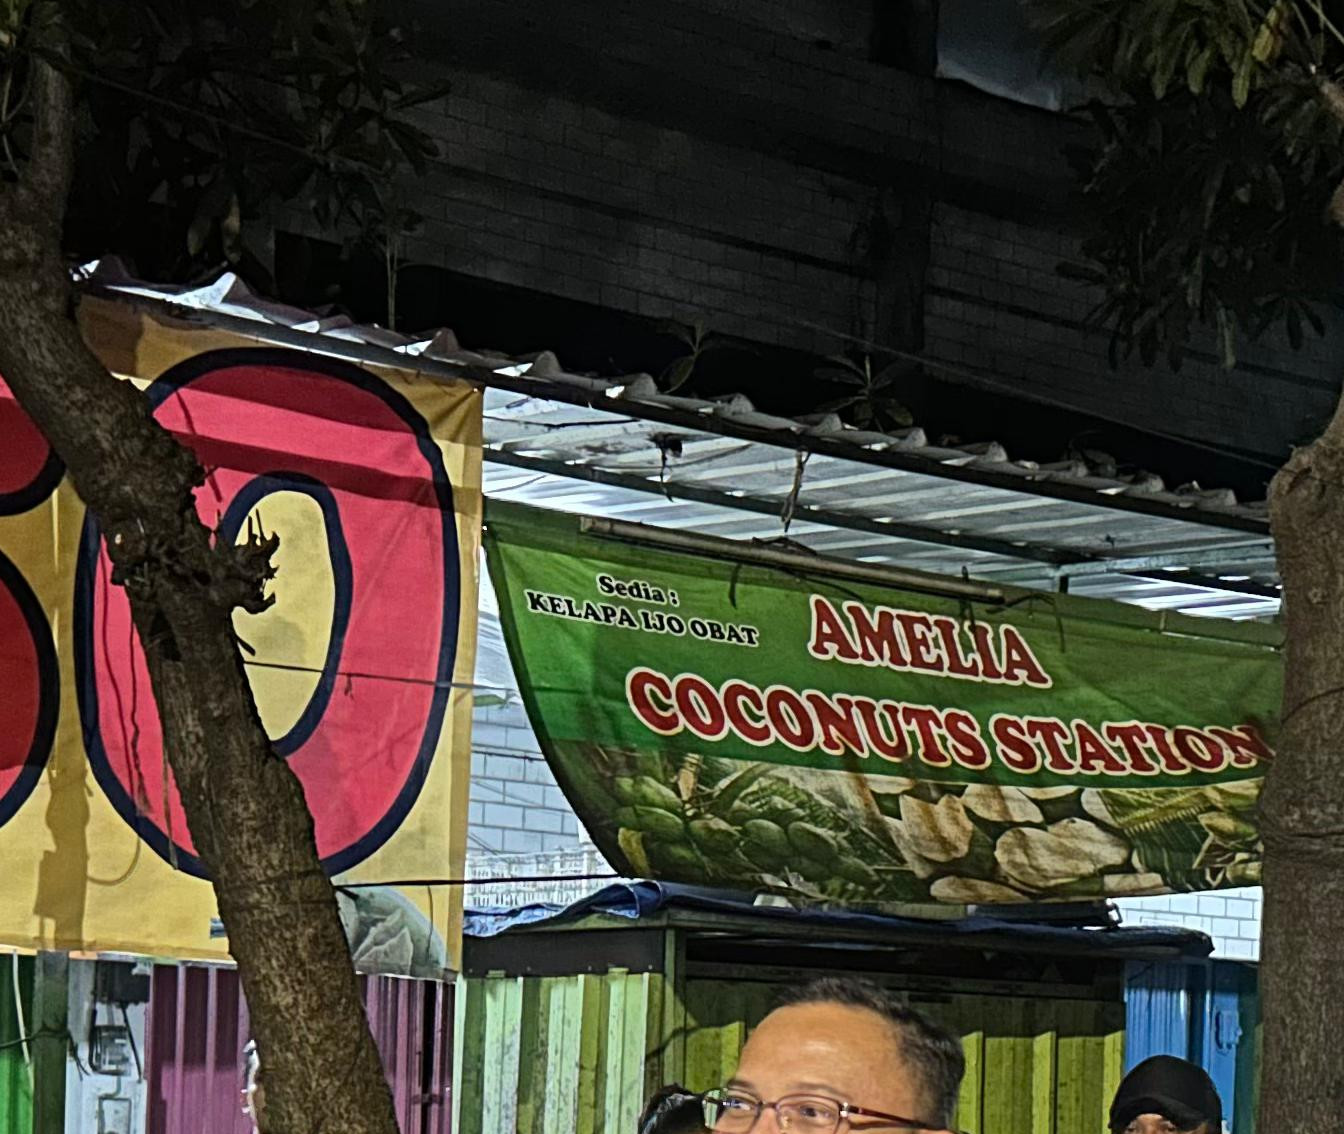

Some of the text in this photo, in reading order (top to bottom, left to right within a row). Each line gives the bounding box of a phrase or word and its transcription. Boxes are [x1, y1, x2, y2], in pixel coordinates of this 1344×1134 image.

[526, 591, 758, 645] KELAPA IJO OBAT
[598, 575, 665, 603] Sedia
[811, 597, 1052, 686] AMELIA
[628, 669, 1277, 776] COCONUTS STATION
